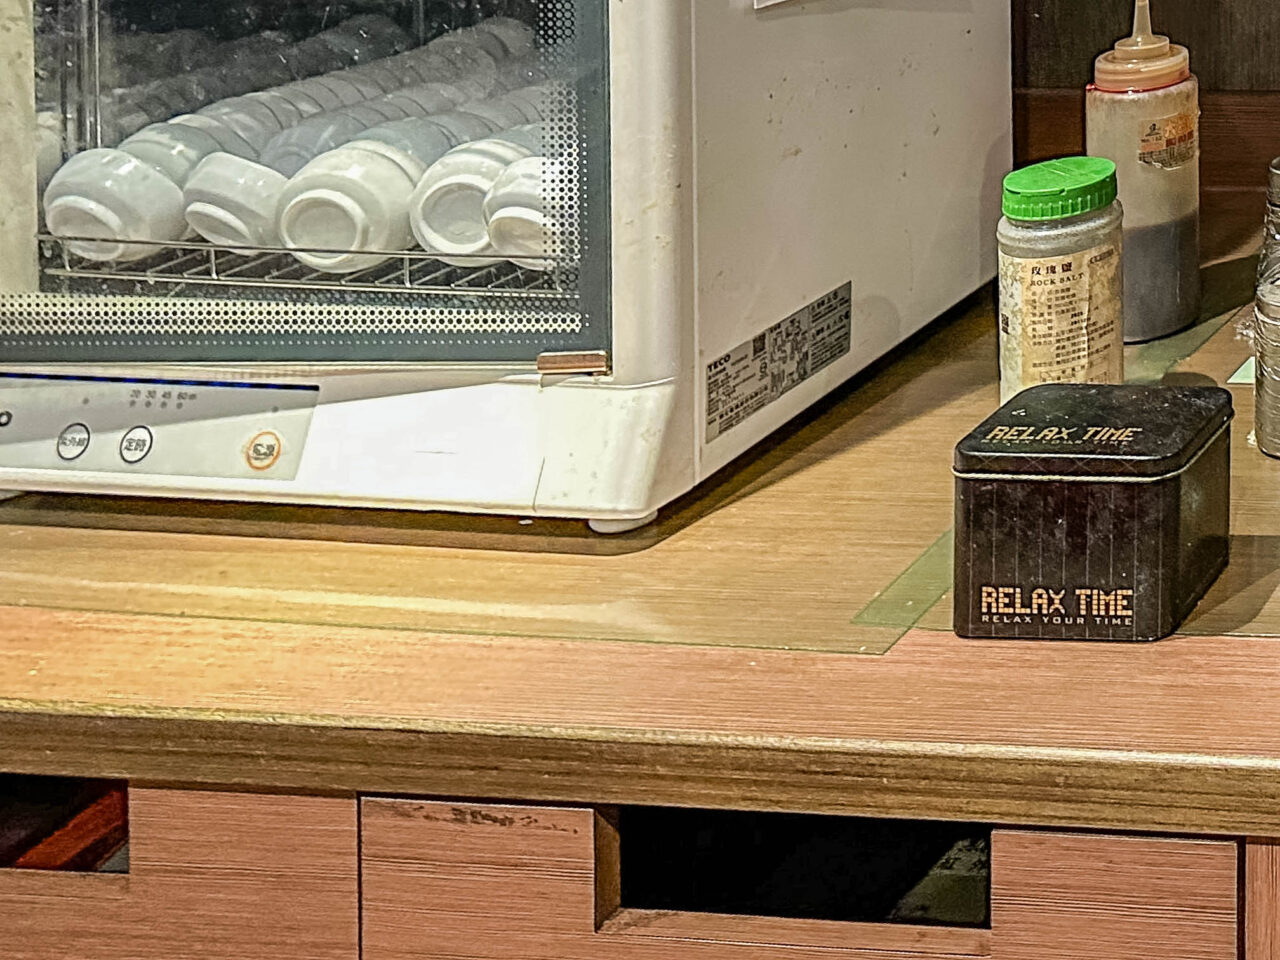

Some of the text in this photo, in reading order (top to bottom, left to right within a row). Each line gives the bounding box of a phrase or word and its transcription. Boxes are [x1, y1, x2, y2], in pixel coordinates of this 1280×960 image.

[1030, 272, 1084, 287] ROCK SALT
[707, 353, 731, 372] TECO
[985, 426, 1143, 440] RELAX TIME
[981, 586, 1133, 616] RELAX TIME
[982, 615, 1133, 626] RELAX YOUR TIME
